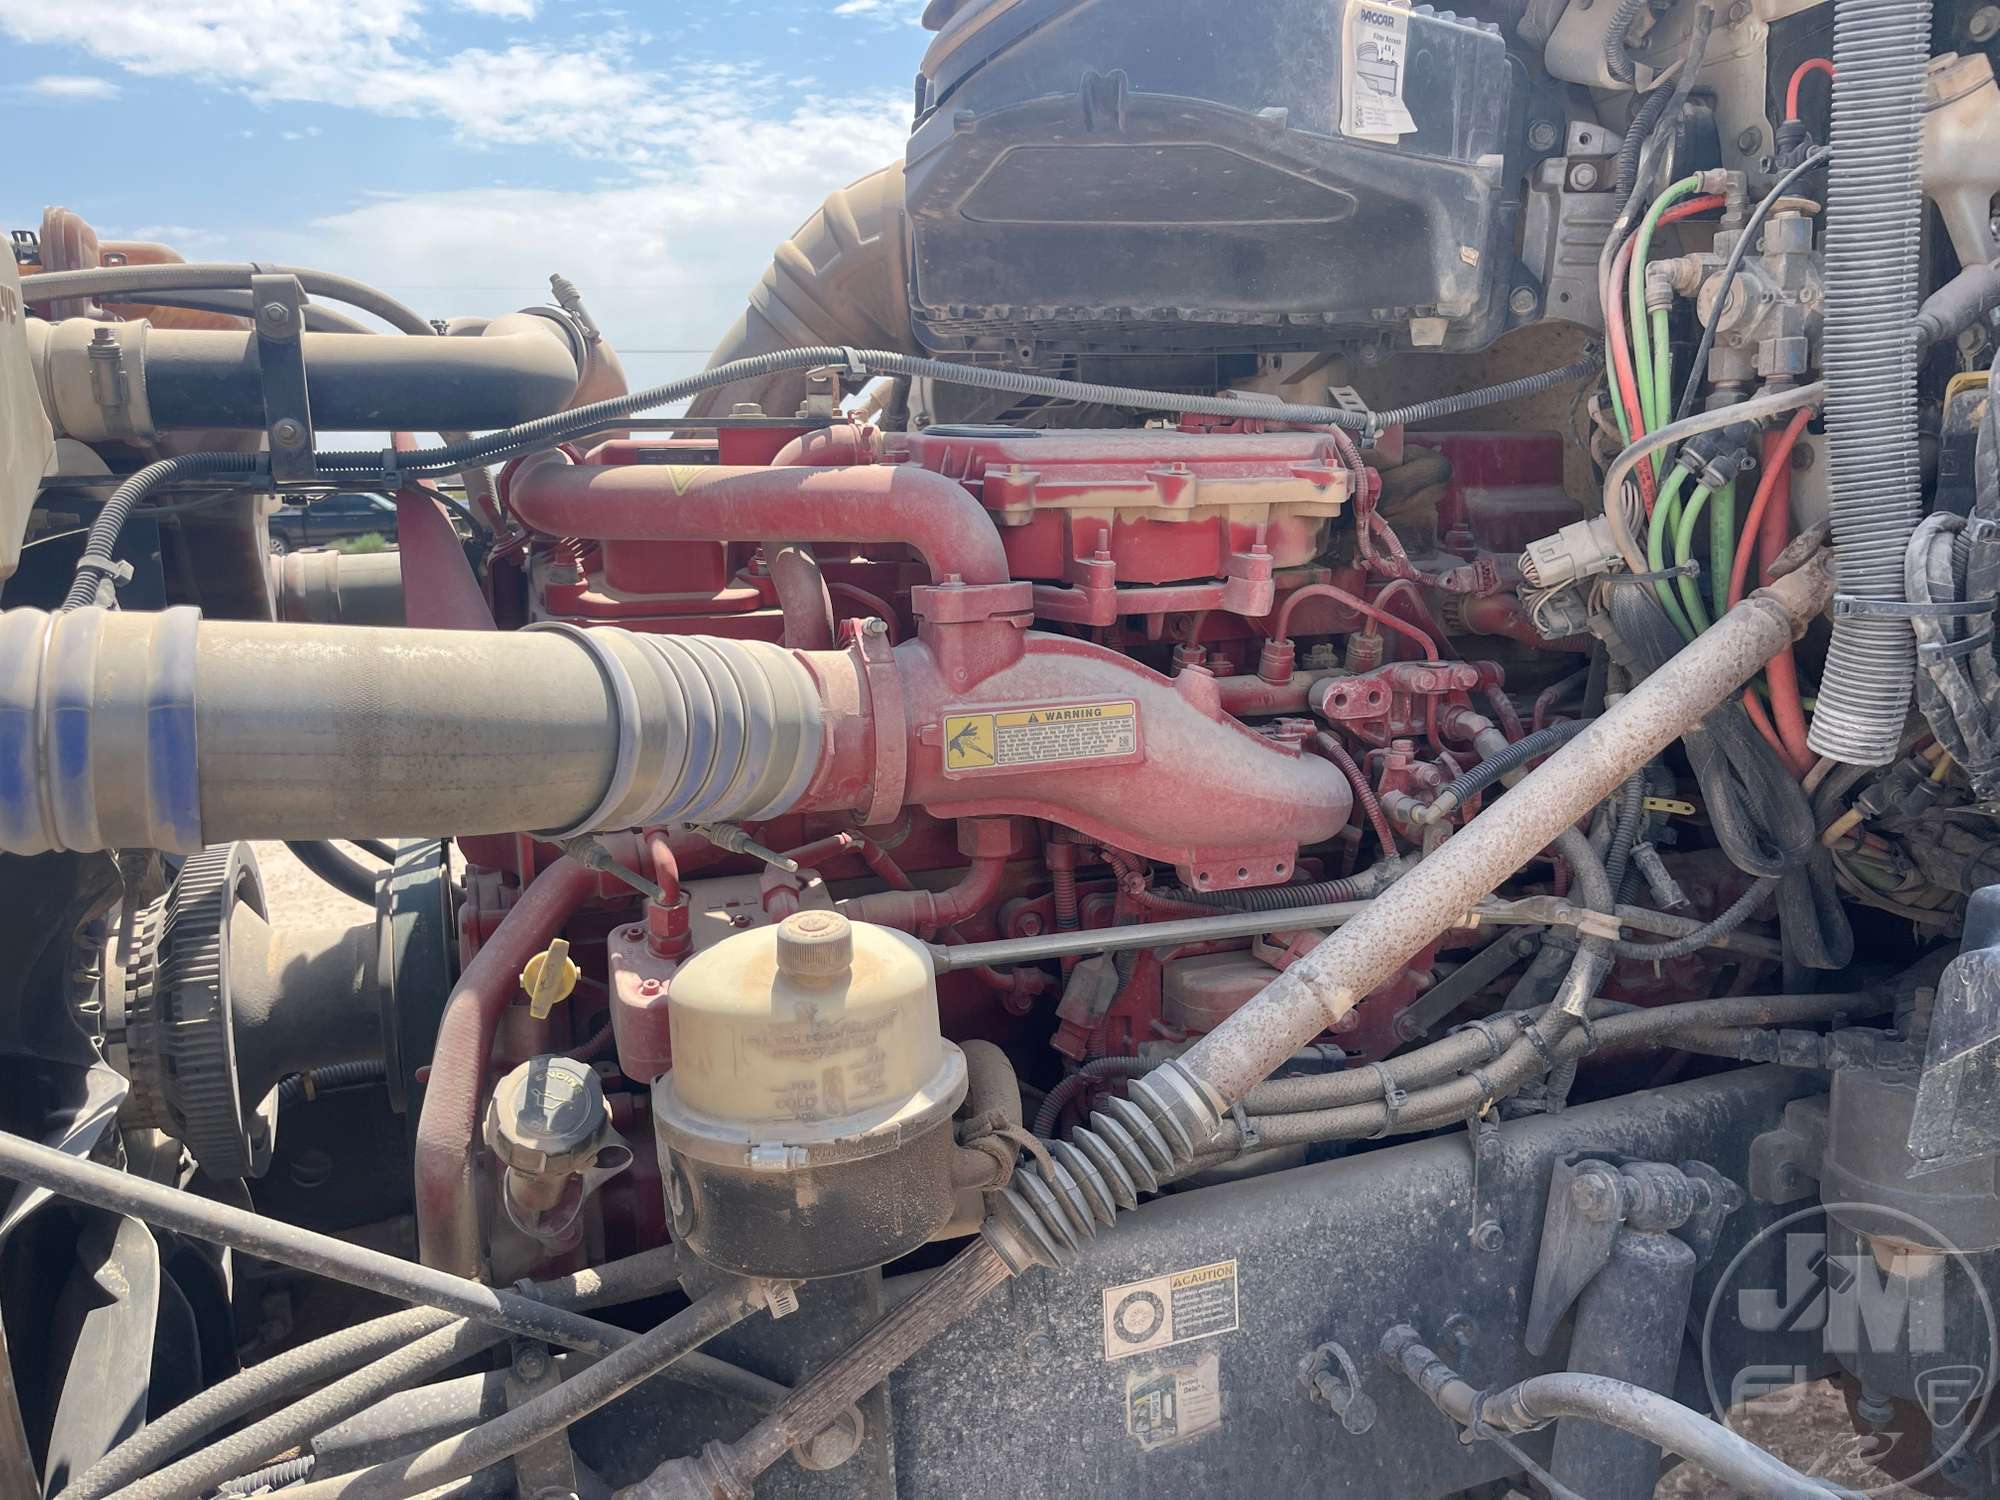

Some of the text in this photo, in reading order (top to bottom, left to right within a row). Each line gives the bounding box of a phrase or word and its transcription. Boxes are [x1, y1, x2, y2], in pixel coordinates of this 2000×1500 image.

[1360, 8, 1395, 28] PACCAR
[1045, 707, 1102, 723] WARNING
[1182, 1264, 1233, 1287] CAUTION
